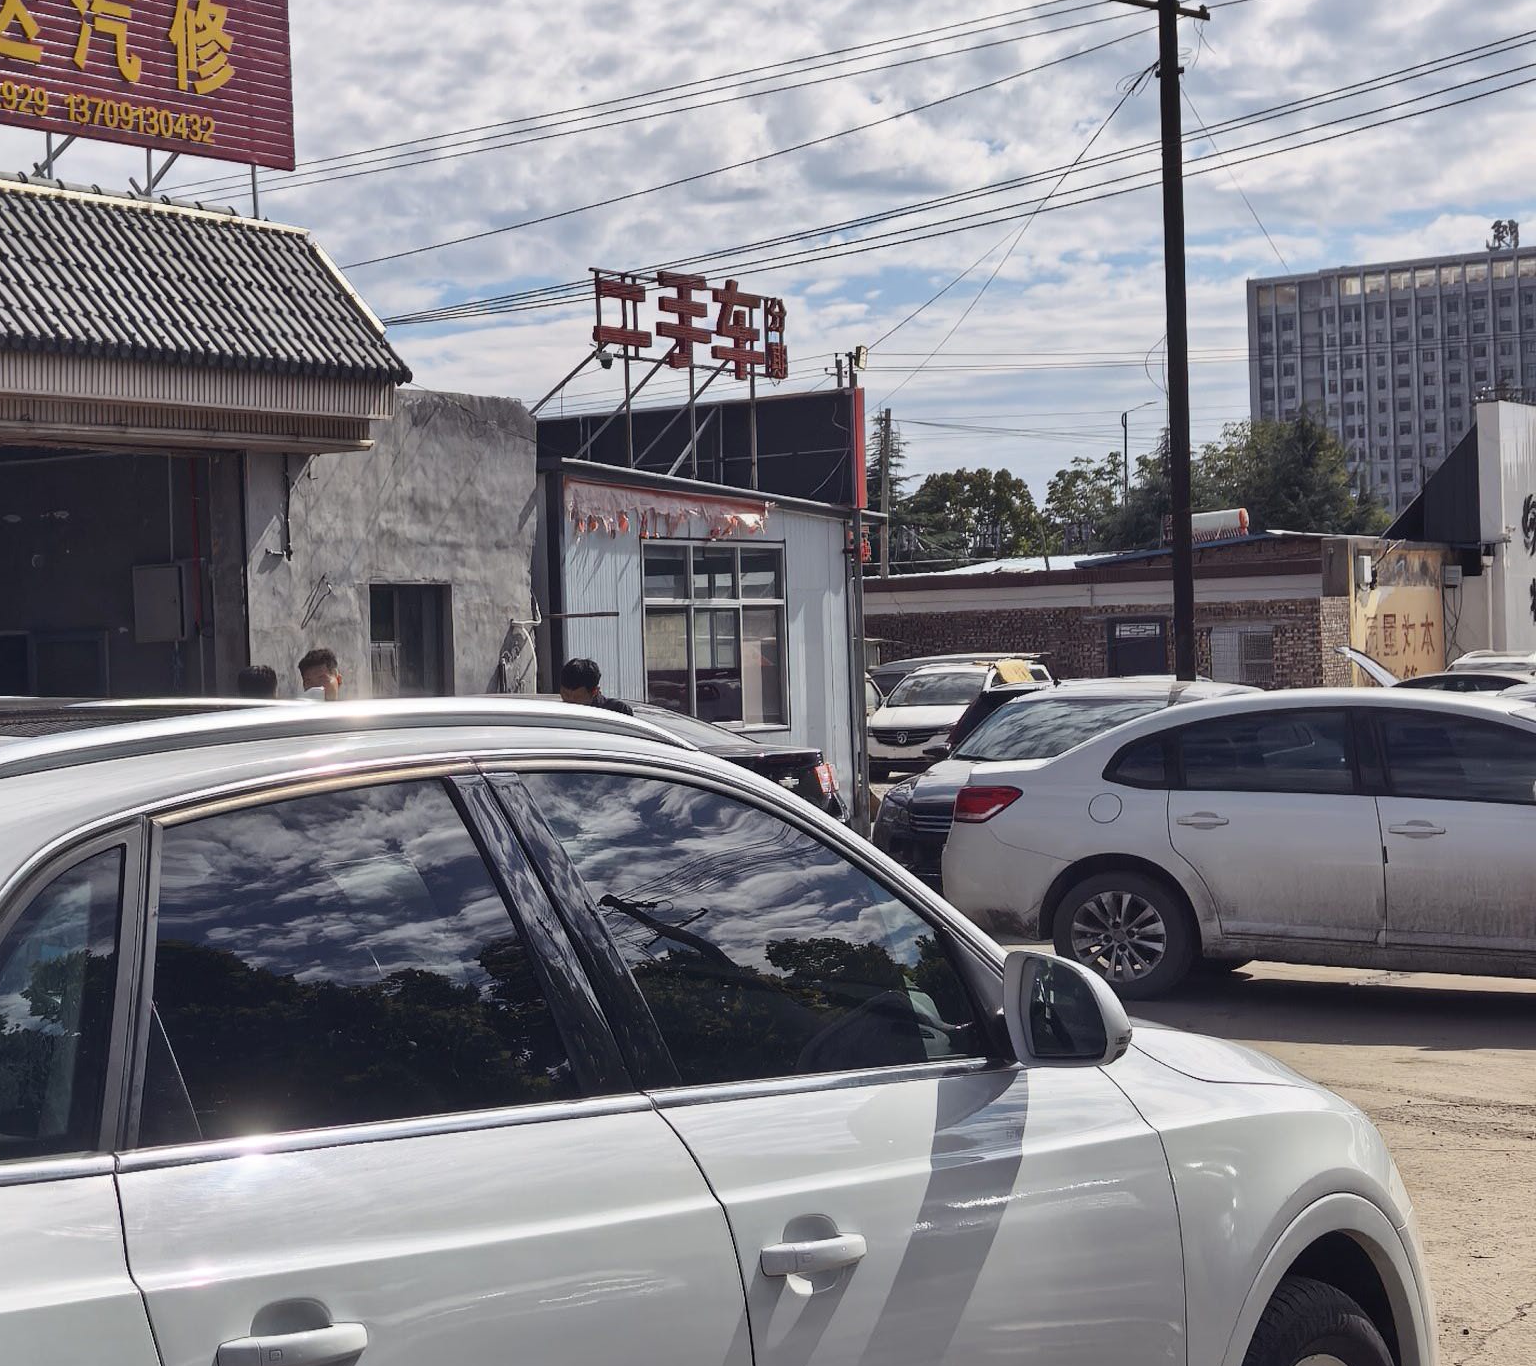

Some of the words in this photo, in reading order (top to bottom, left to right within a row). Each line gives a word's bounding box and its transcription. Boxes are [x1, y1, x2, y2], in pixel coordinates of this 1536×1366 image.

[64, 92, 216, 145] 13709130432
[592, 270, 765, 381] 二手车
